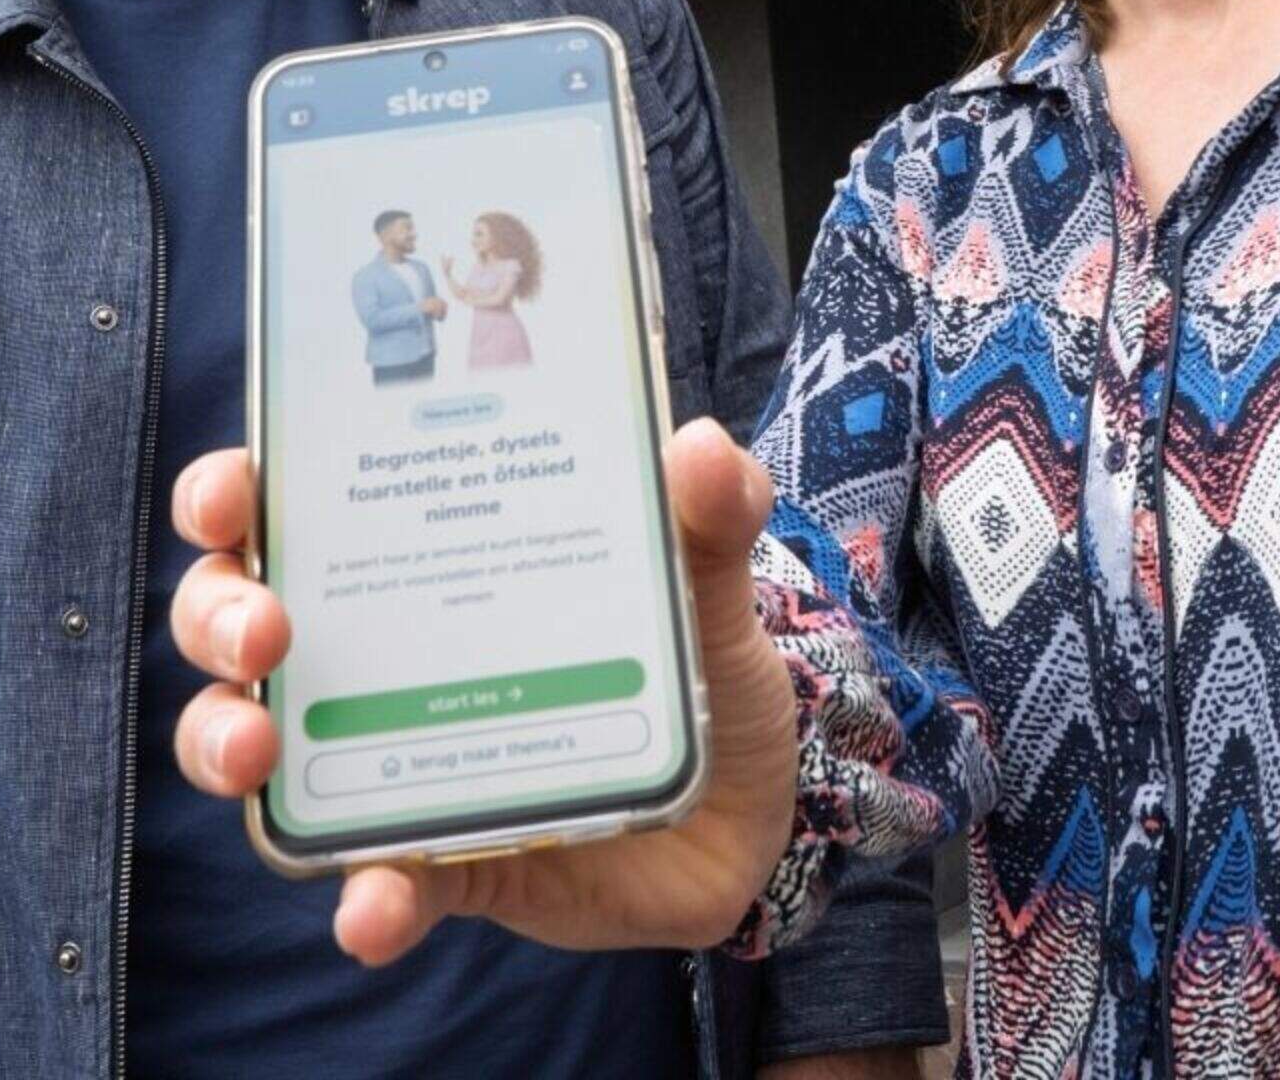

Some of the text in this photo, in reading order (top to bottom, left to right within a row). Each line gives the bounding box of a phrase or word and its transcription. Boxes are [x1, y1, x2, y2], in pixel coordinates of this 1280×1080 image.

[386, 85, 492, 116] skrep
[357, 429, 562, 473] Begroetsje, dysels
[348, 473, 453, 503] foarstelle
[459, 470, 488, 489] en
[425, 498, 502, 524] nimme
[427, 690, 500, 713] start les
[410, 751, 459, 770] terug
[462, 745, 500, 761] naar
